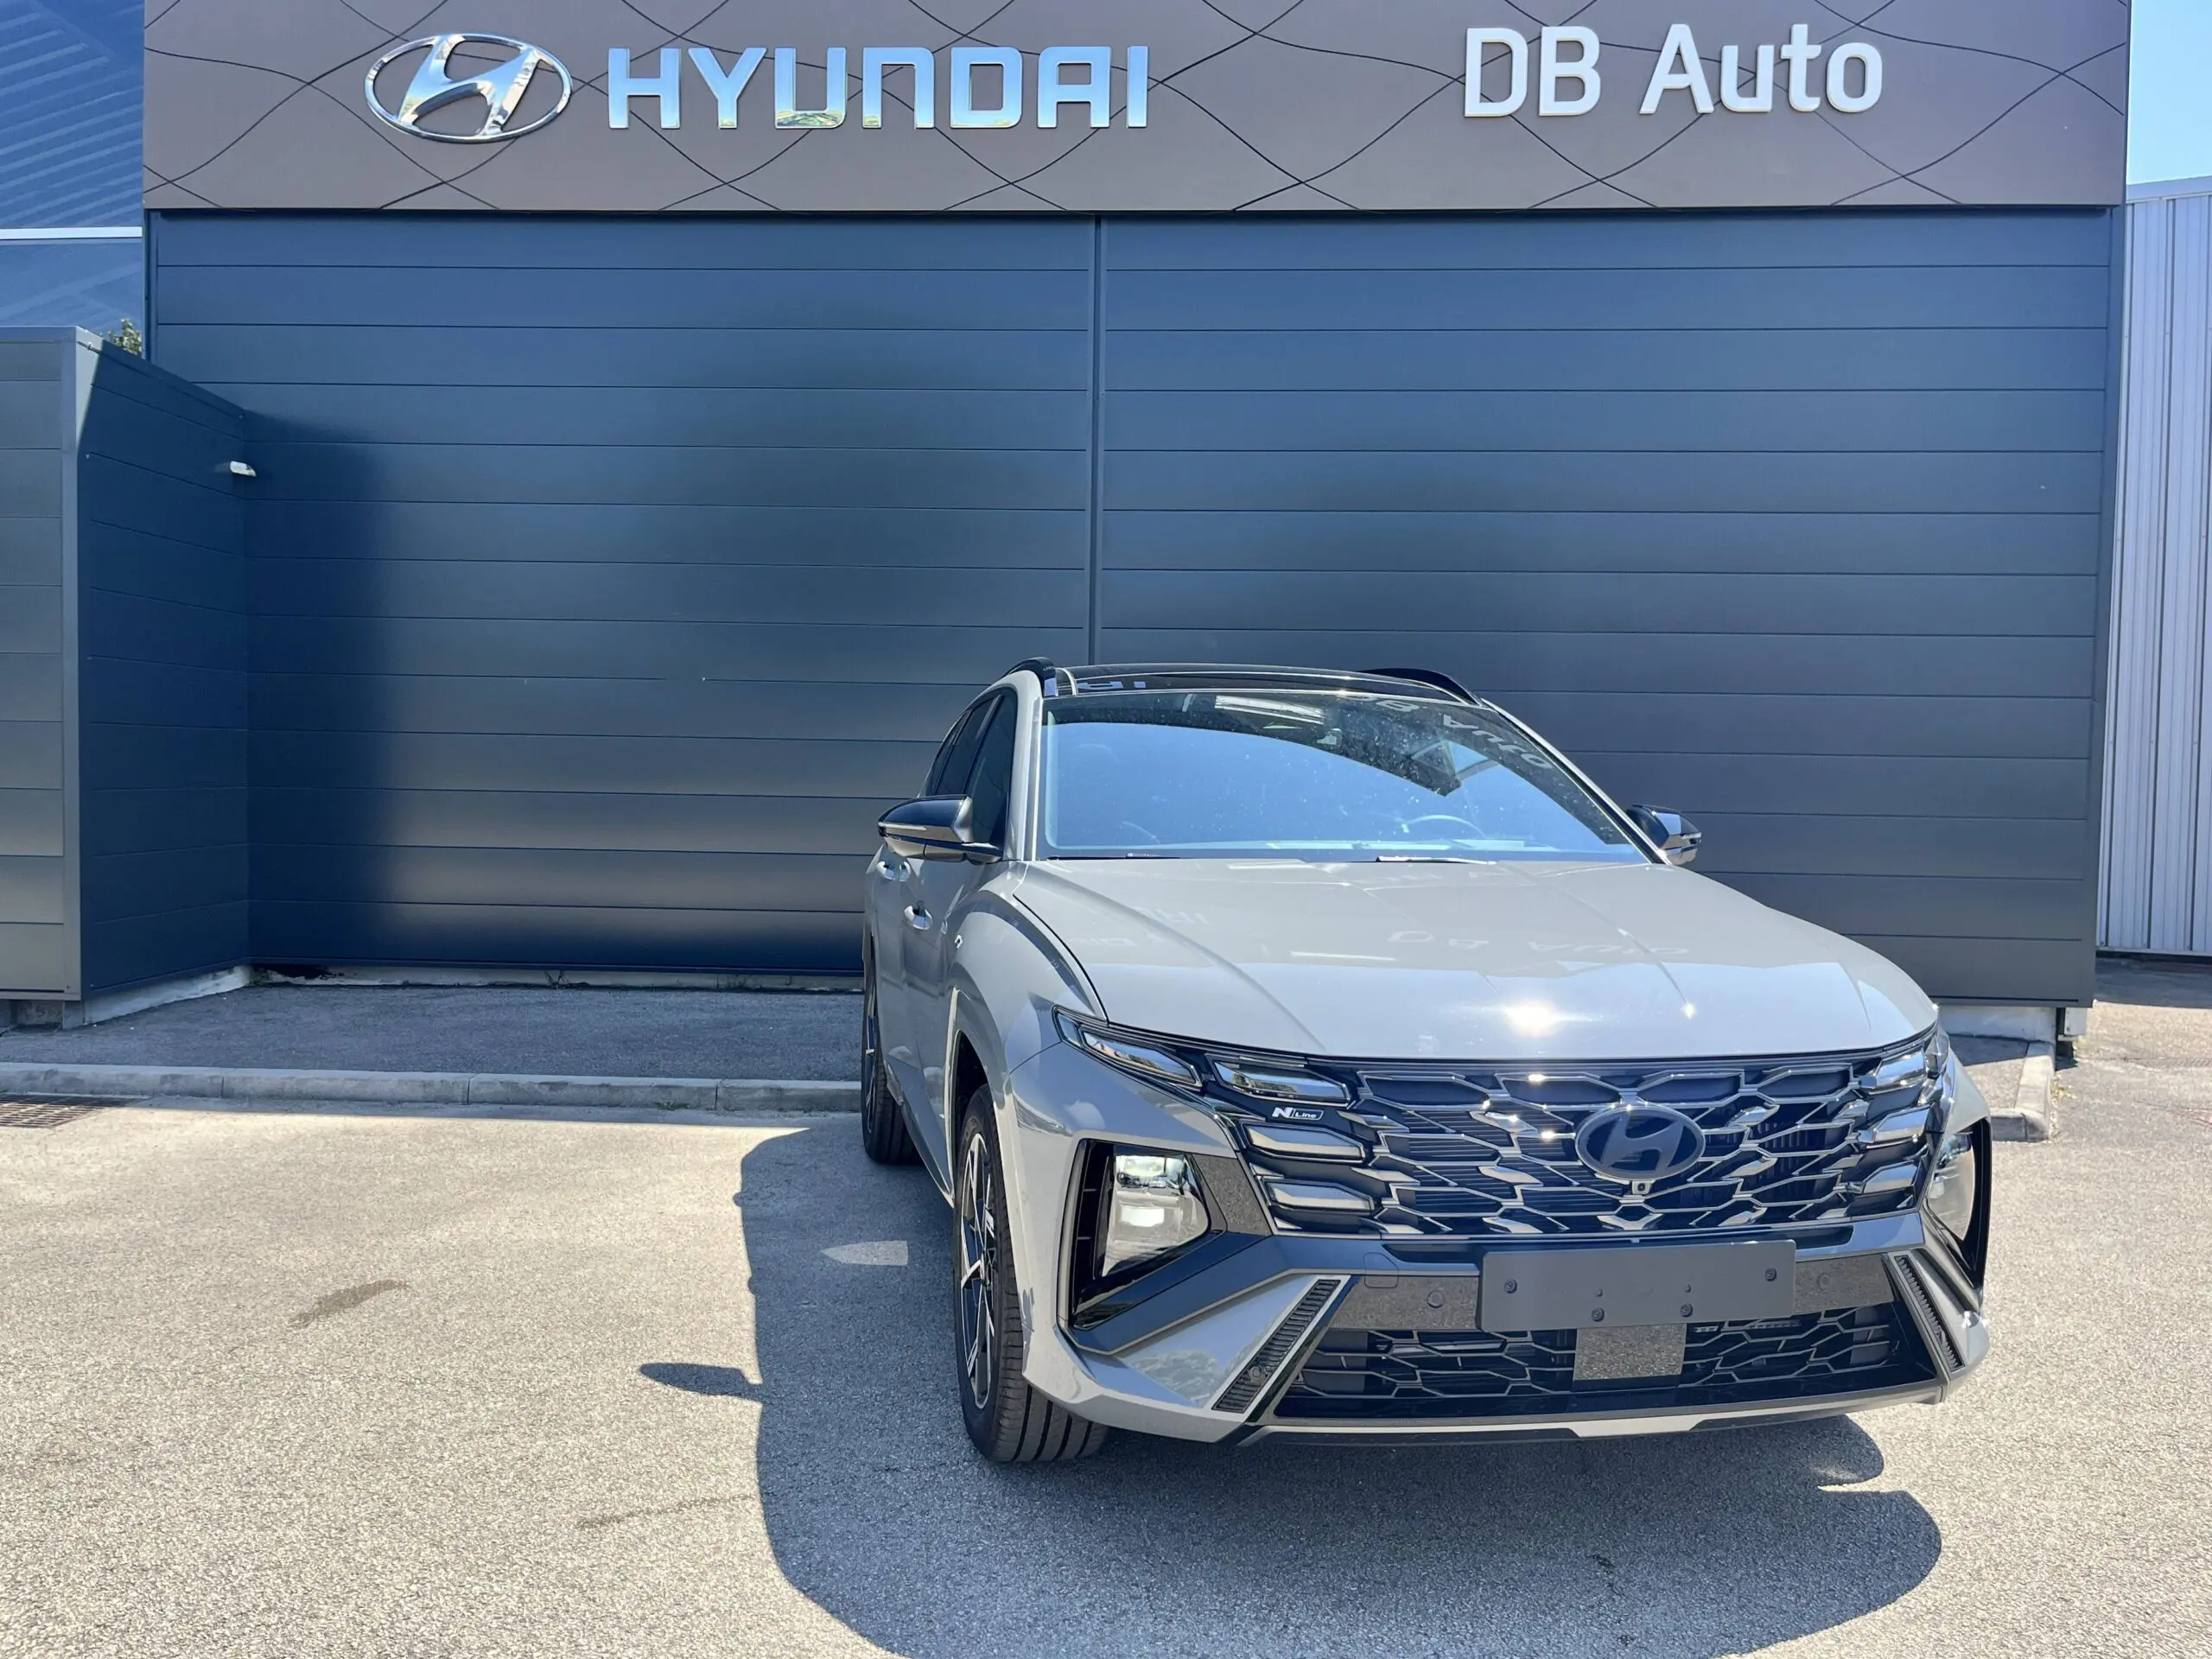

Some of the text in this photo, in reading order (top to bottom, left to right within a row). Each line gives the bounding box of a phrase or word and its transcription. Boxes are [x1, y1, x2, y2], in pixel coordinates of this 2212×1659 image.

[607, 46, 1148, 130] HYUNDAI
[1464, 23, 1883, 118] DB Auto
[1272, 1107, 1294, 1118] N
